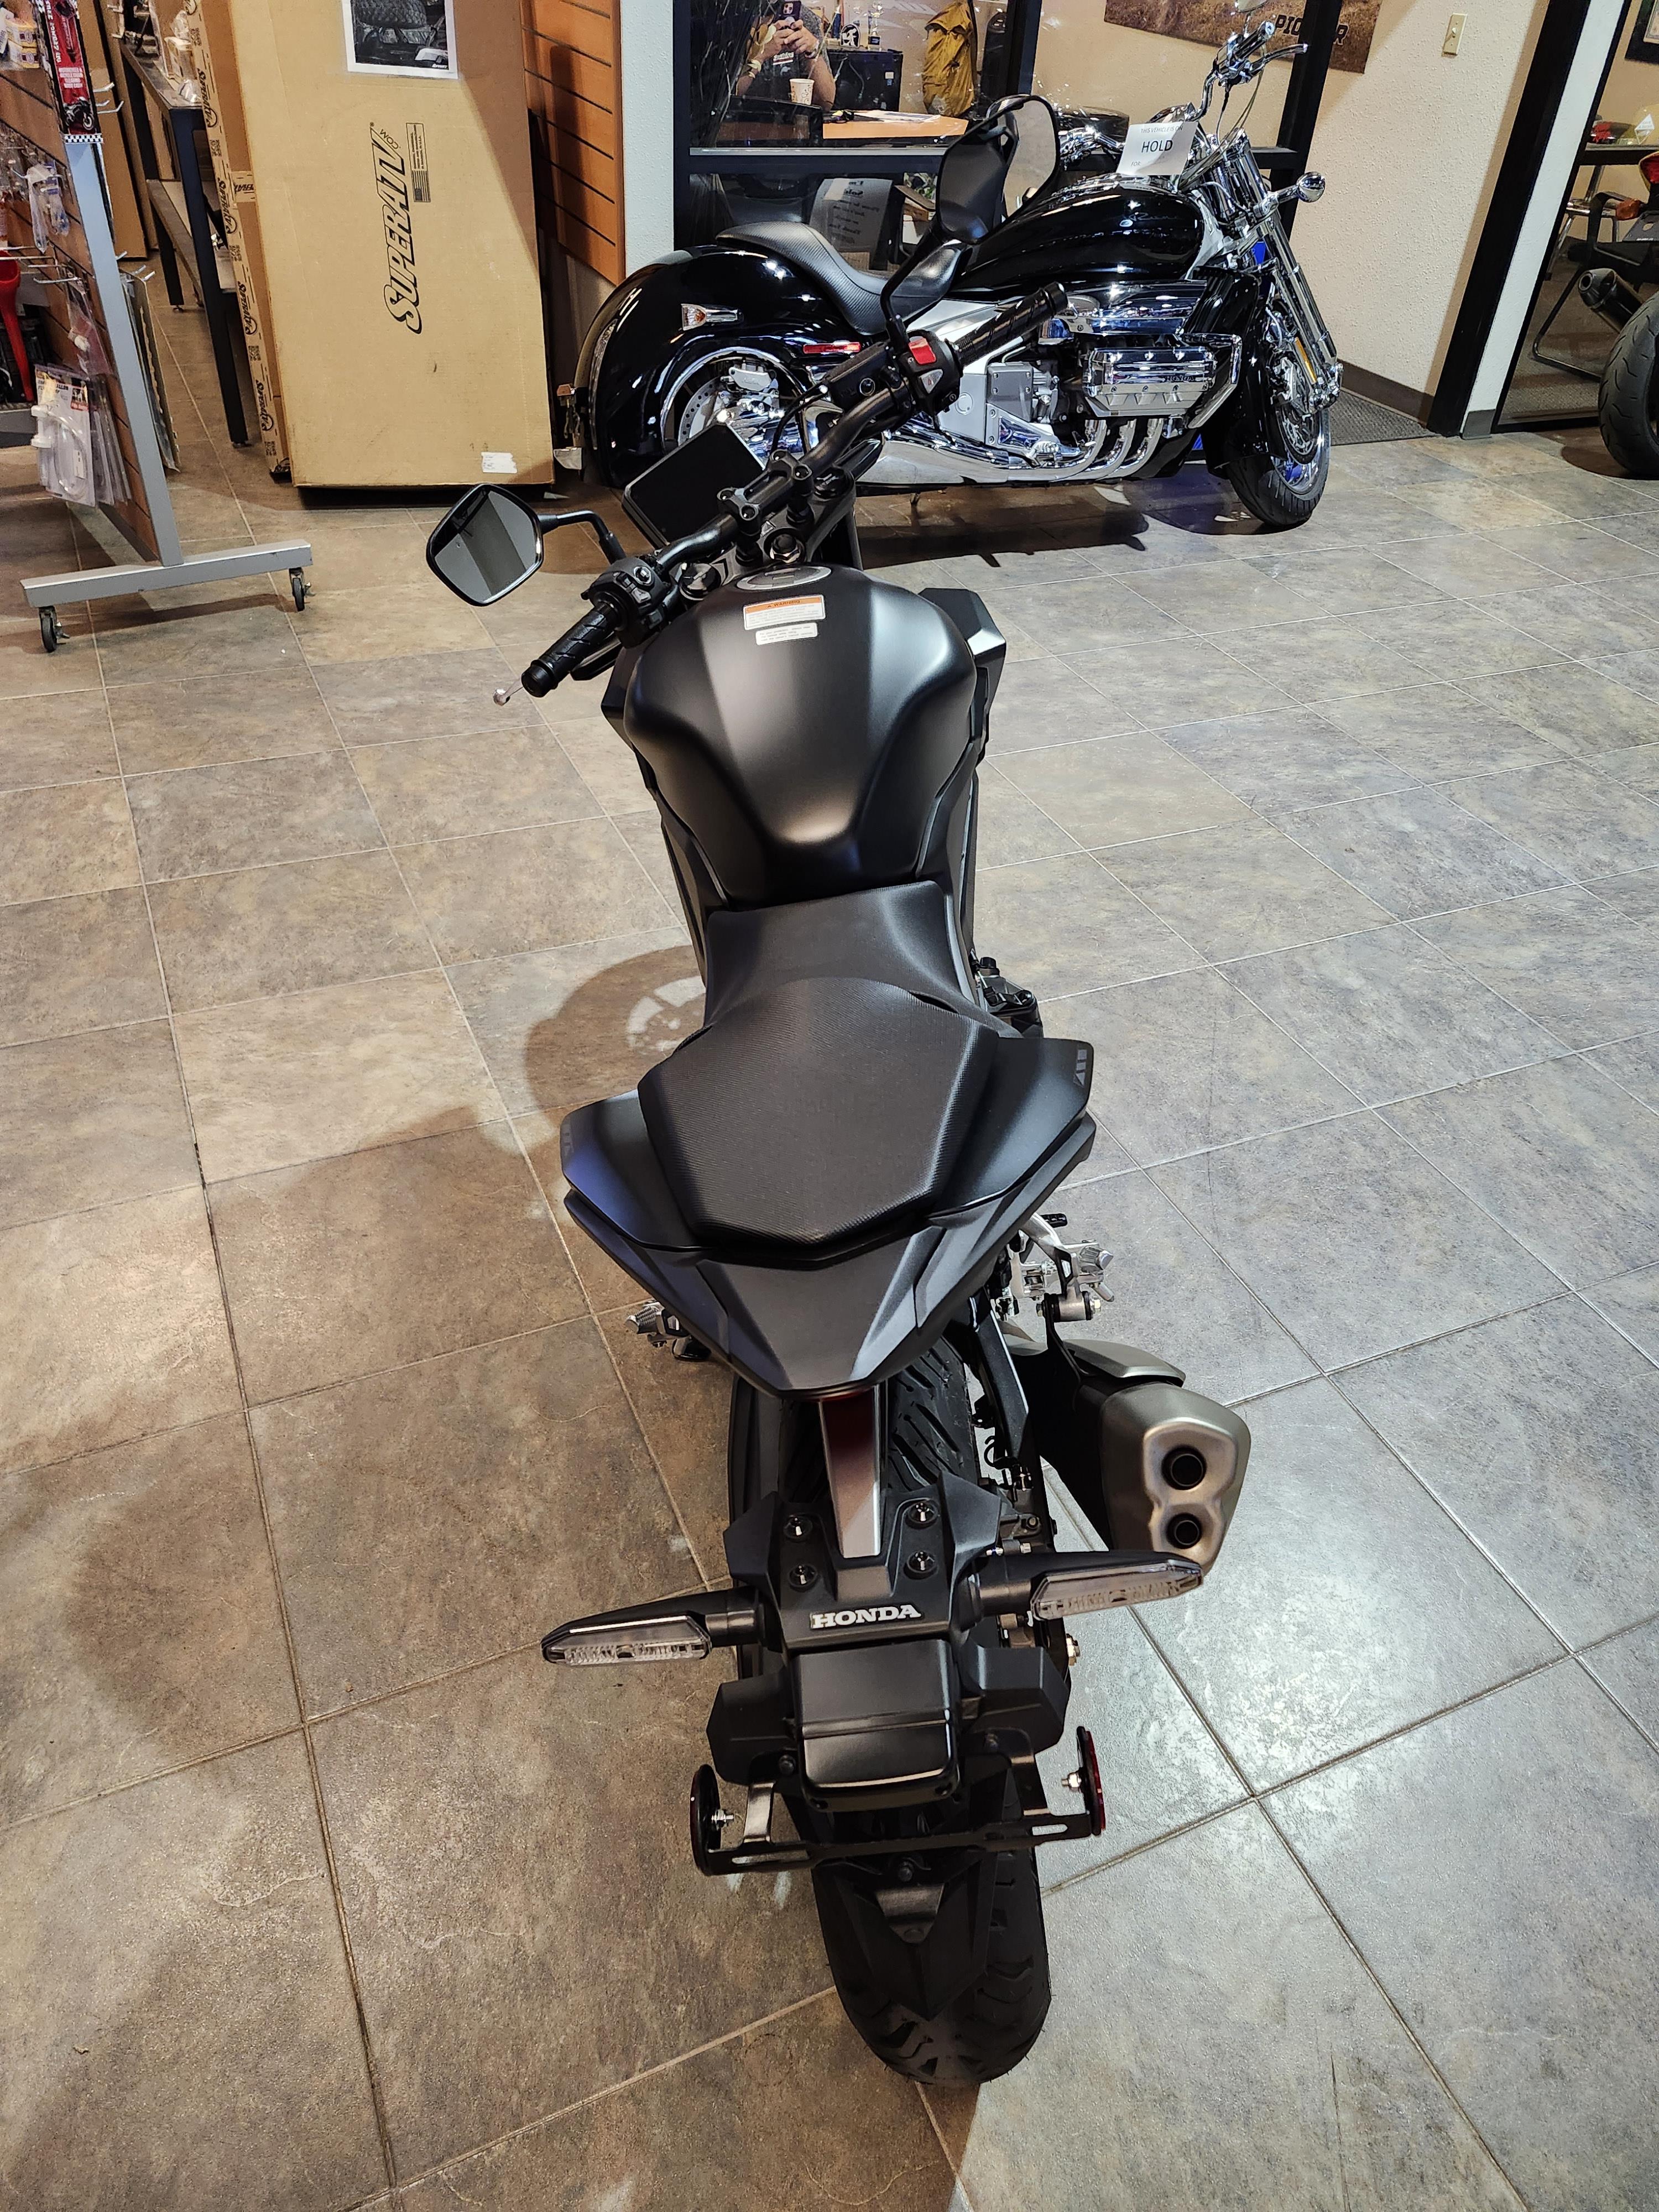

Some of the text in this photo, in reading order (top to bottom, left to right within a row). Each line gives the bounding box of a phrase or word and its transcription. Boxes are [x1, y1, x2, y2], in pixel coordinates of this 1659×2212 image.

[1275, 14, 1349, 45] PIOR
[1141, 140, 1173, 153] HOLD
[369, 127, 422, 335] SUPERATV .COM
[812, 1604, 922, 1629] HONDA
